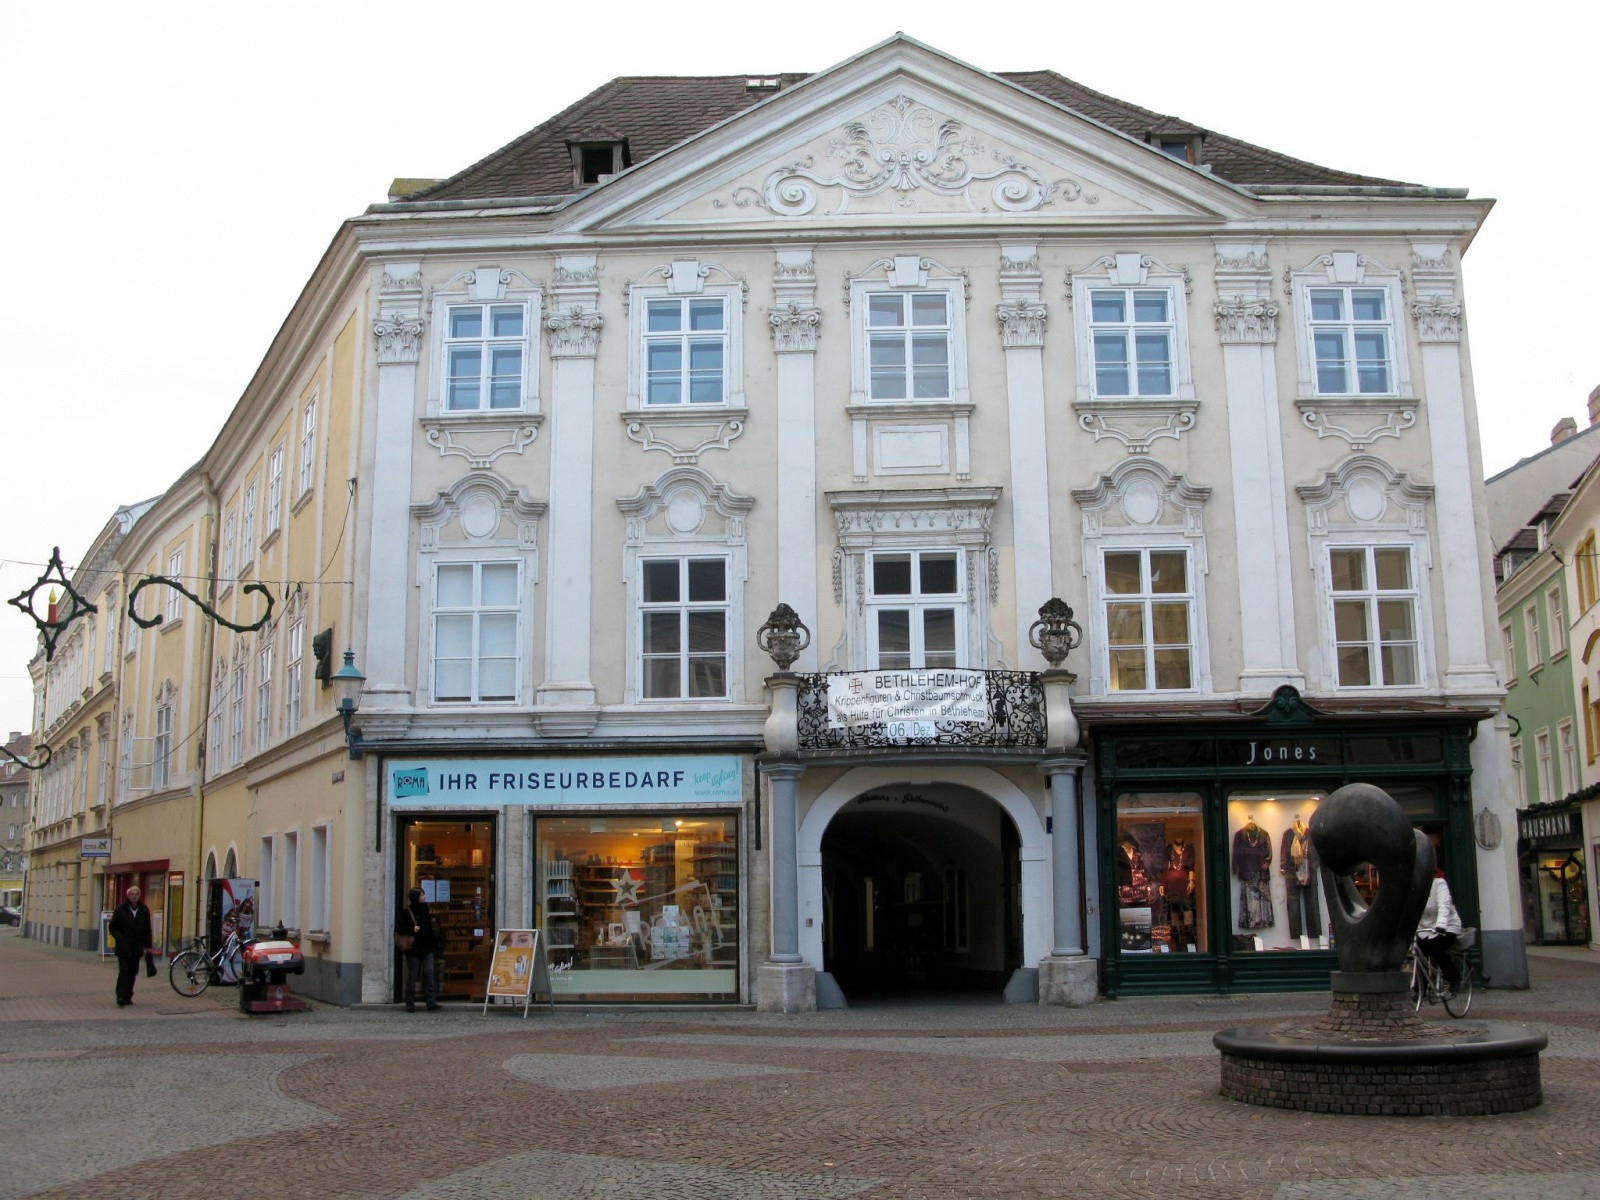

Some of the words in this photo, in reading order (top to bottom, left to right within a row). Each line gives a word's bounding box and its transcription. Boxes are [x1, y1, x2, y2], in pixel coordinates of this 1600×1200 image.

[875, 673, 982, 689] BETHLEHEM-HOF
[835, 692, 892, 707] Krippenfiguren
[894, 690, 901, 702] &
[903, 688, 984, 703] Christbaumschmuck
[836, 712, 848, 723] als
[850, 708, 869, 721] Hilfe
[872, 707, 884, 720] für
[887, 705, 925, 718] Christen
[930, 707, 937, 716] in
[940, 704, 985, 718] Bethlehem
[889, 723, 909, 737] 06.
[1246, 742, 1316, 765] Jones
[439, 773, 478, 790] IHR
[489, 770, 685, 790] FRISEURBEDARF
[694, 771, 711, 785] keep
[711, 757, 739, 788] styling!
[397, 776, 425, 789] ROMA
[694, 788, 739, 796] www.roma.at
[1522, 813, 1571, 839] HAUSMANN
